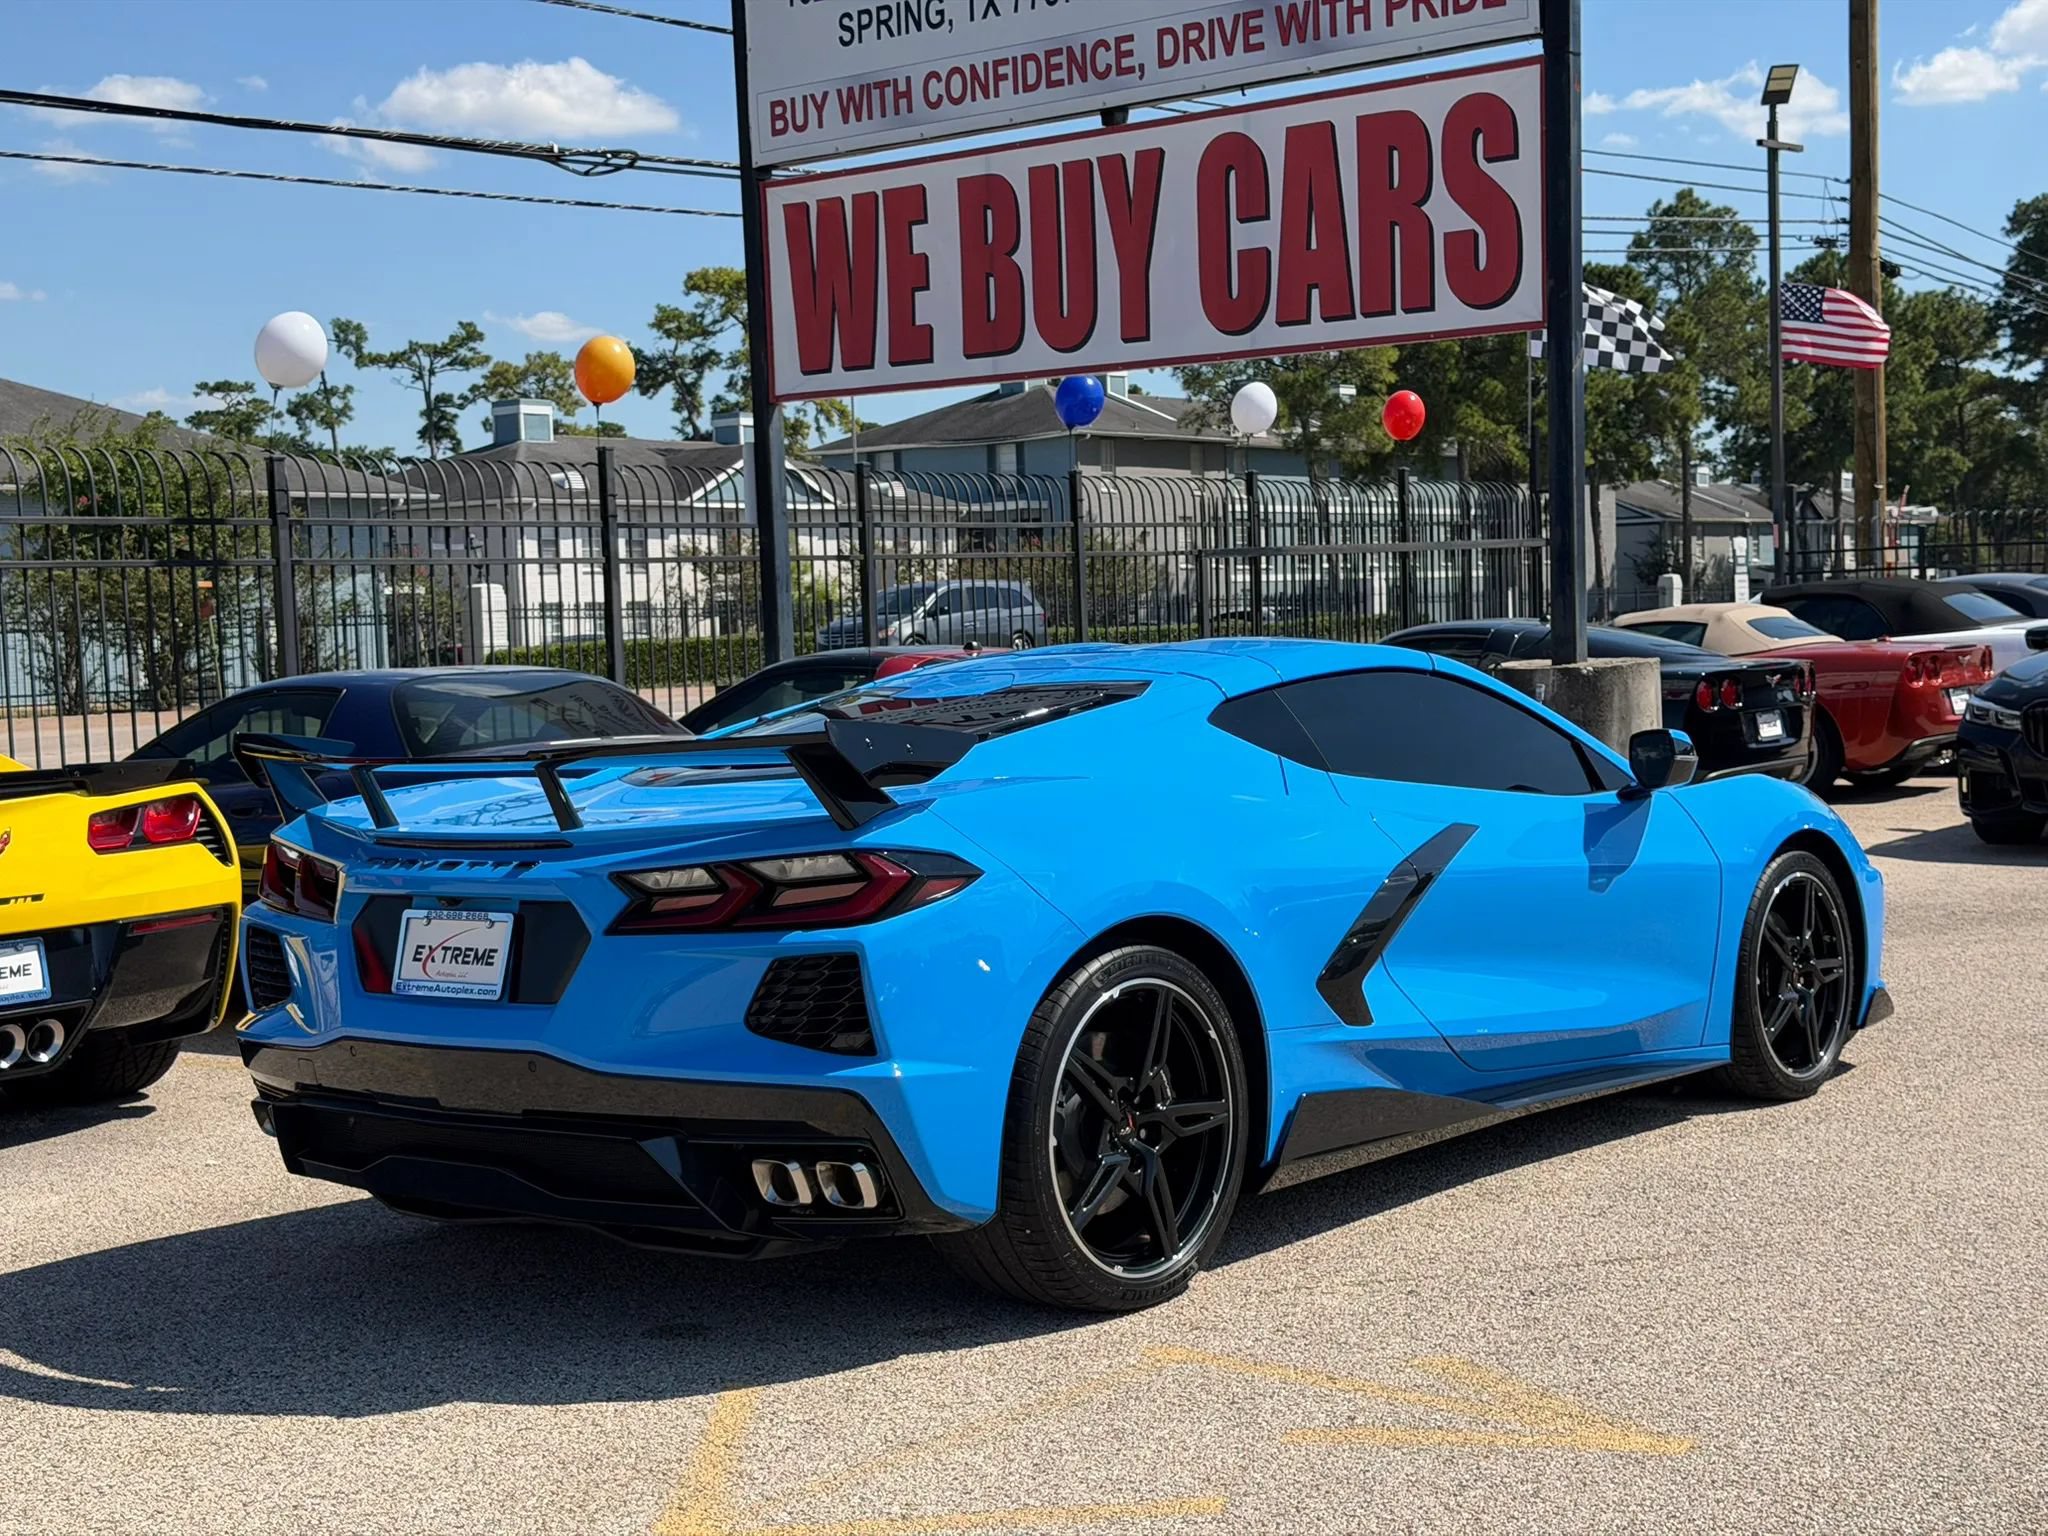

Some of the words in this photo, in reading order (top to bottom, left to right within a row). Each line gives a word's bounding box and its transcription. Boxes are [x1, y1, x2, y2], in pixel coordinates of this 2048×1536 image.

[838, 0, 954, 47] SPRING,
[770, 91, 829, 137] BUY
[836, 75, 914, 125] WITH
[922, 34, 1145, 110] CONFIDENCE,
[1157, 8, 1265, 69] DRIVE
[1275, 0, 1372, 47] WITH
[782, 183, 934, 376] WE
[957, 147, 1166, 360] BUY
[1196, 92, 1524, 336] CARS
[412, 945, 499, 967] EXTREME
[396, 981, 497, 996] ExtremeAutoplex.com
